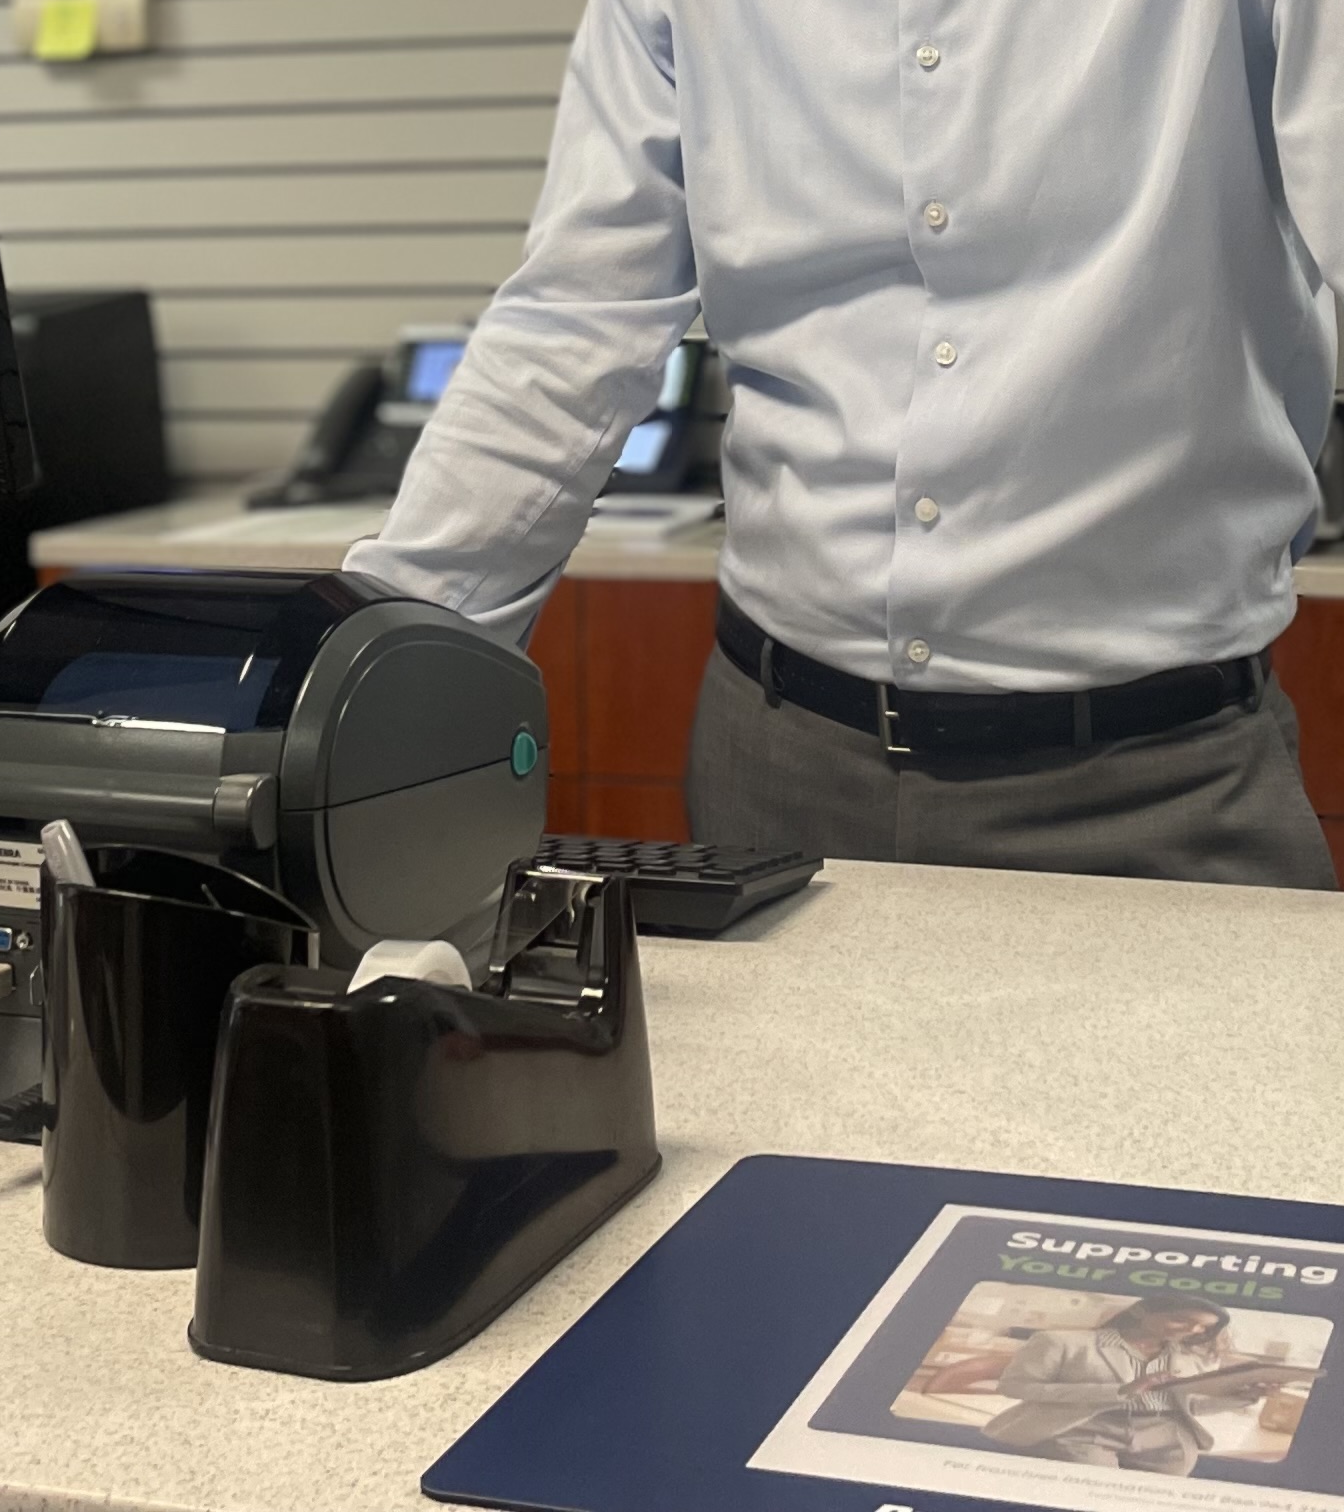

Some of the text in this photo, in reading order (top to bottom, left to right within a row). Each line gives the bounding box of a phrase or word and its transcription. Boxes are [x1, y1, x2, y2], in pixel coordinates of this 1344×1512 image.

[998, 1253, 1285, 1300] Your Goals
[1007, 1232, 1339, 1285] Supporting
